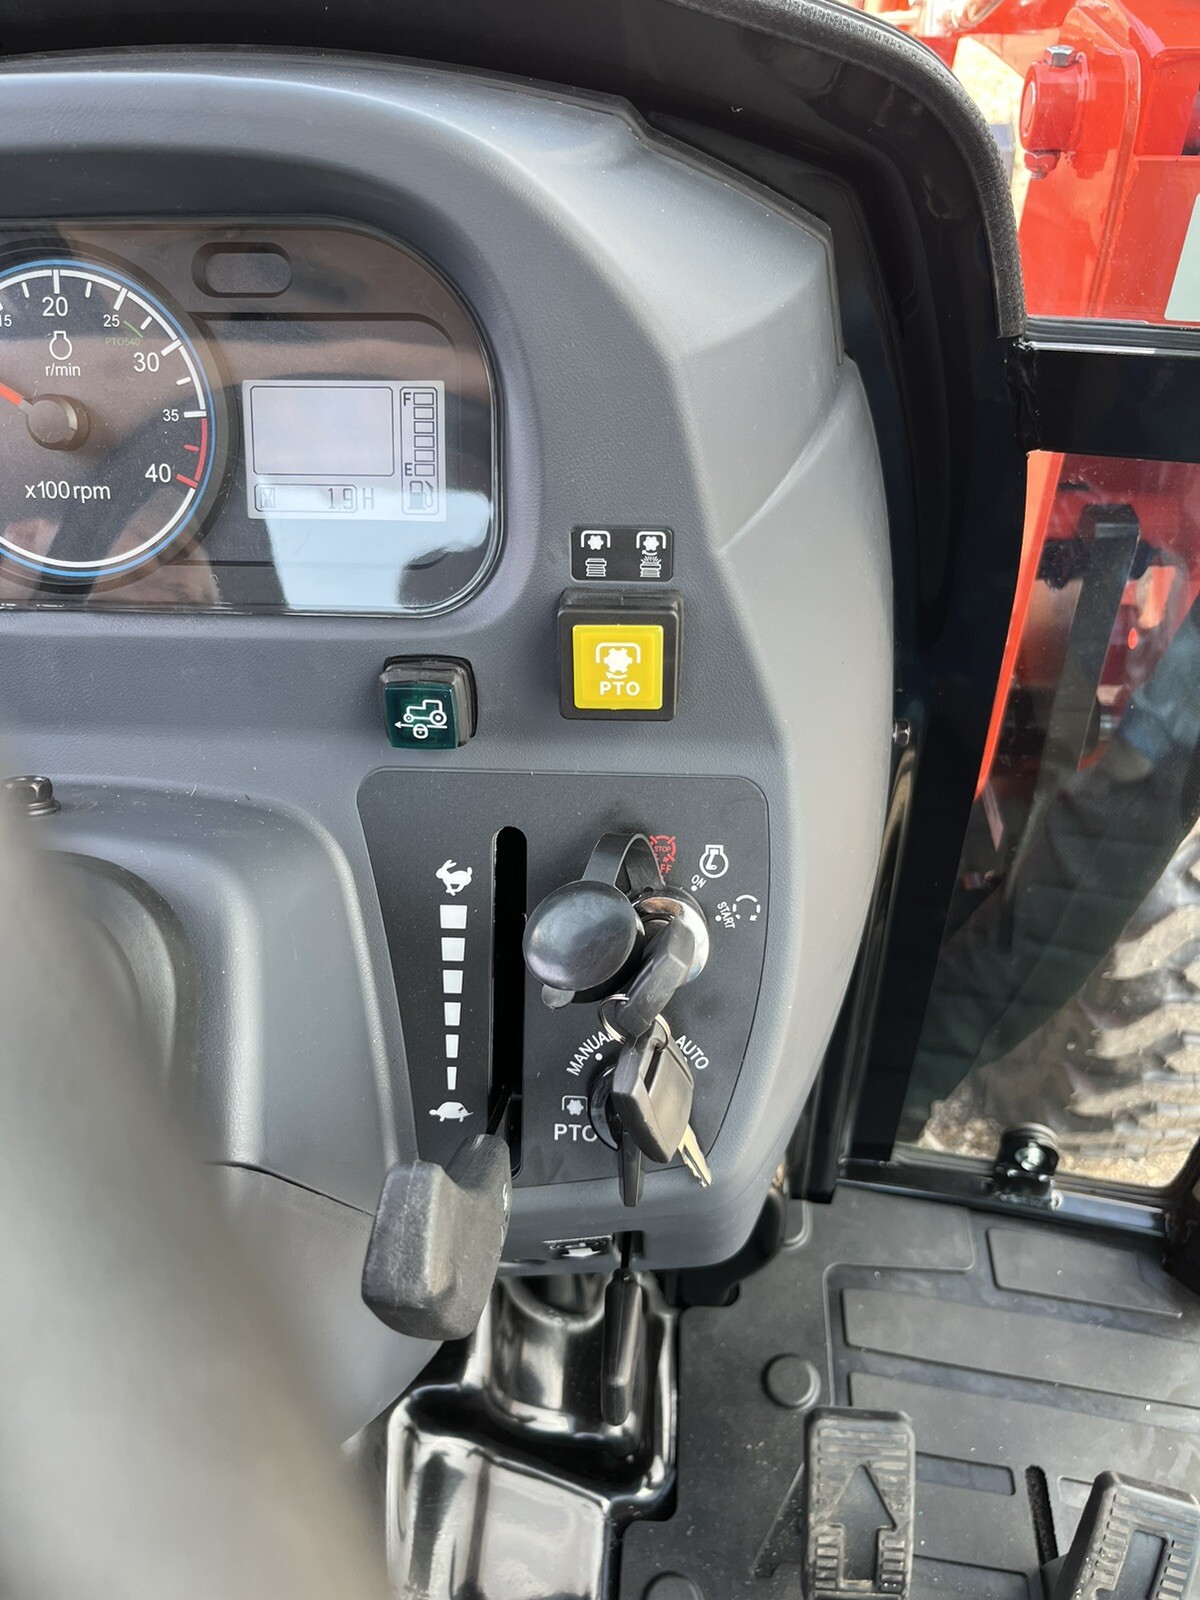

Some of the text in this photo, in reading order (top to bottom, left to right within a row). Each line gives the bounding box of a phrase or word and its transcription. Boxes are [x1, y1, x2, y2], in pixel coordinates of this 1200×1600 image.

[42, 296, 69, 317] 20
[103, 314, 120, 328] 25
[105, 337, 140, 347] PTO540
[45, 362, 81, 377] r/min
[133, 352, 160, 373] 30
[403, 392, 411, 406] F
[162, 409, 179, 422] 35
[145, 463, 172, 483] 40
[404, 462, 413, 476] E
[362, 487, 375, 510] H
[599, 681, 640, 697] PTO
[654, 845, 672, 853] STOP
[659, 863, 673, 875] FF
[691, 874, 707, 889] ON
[717, 901, 736, 929] START
[675, 1034, 710, 1070] AUTO
[553, 1123, 598, 1142] PTO
